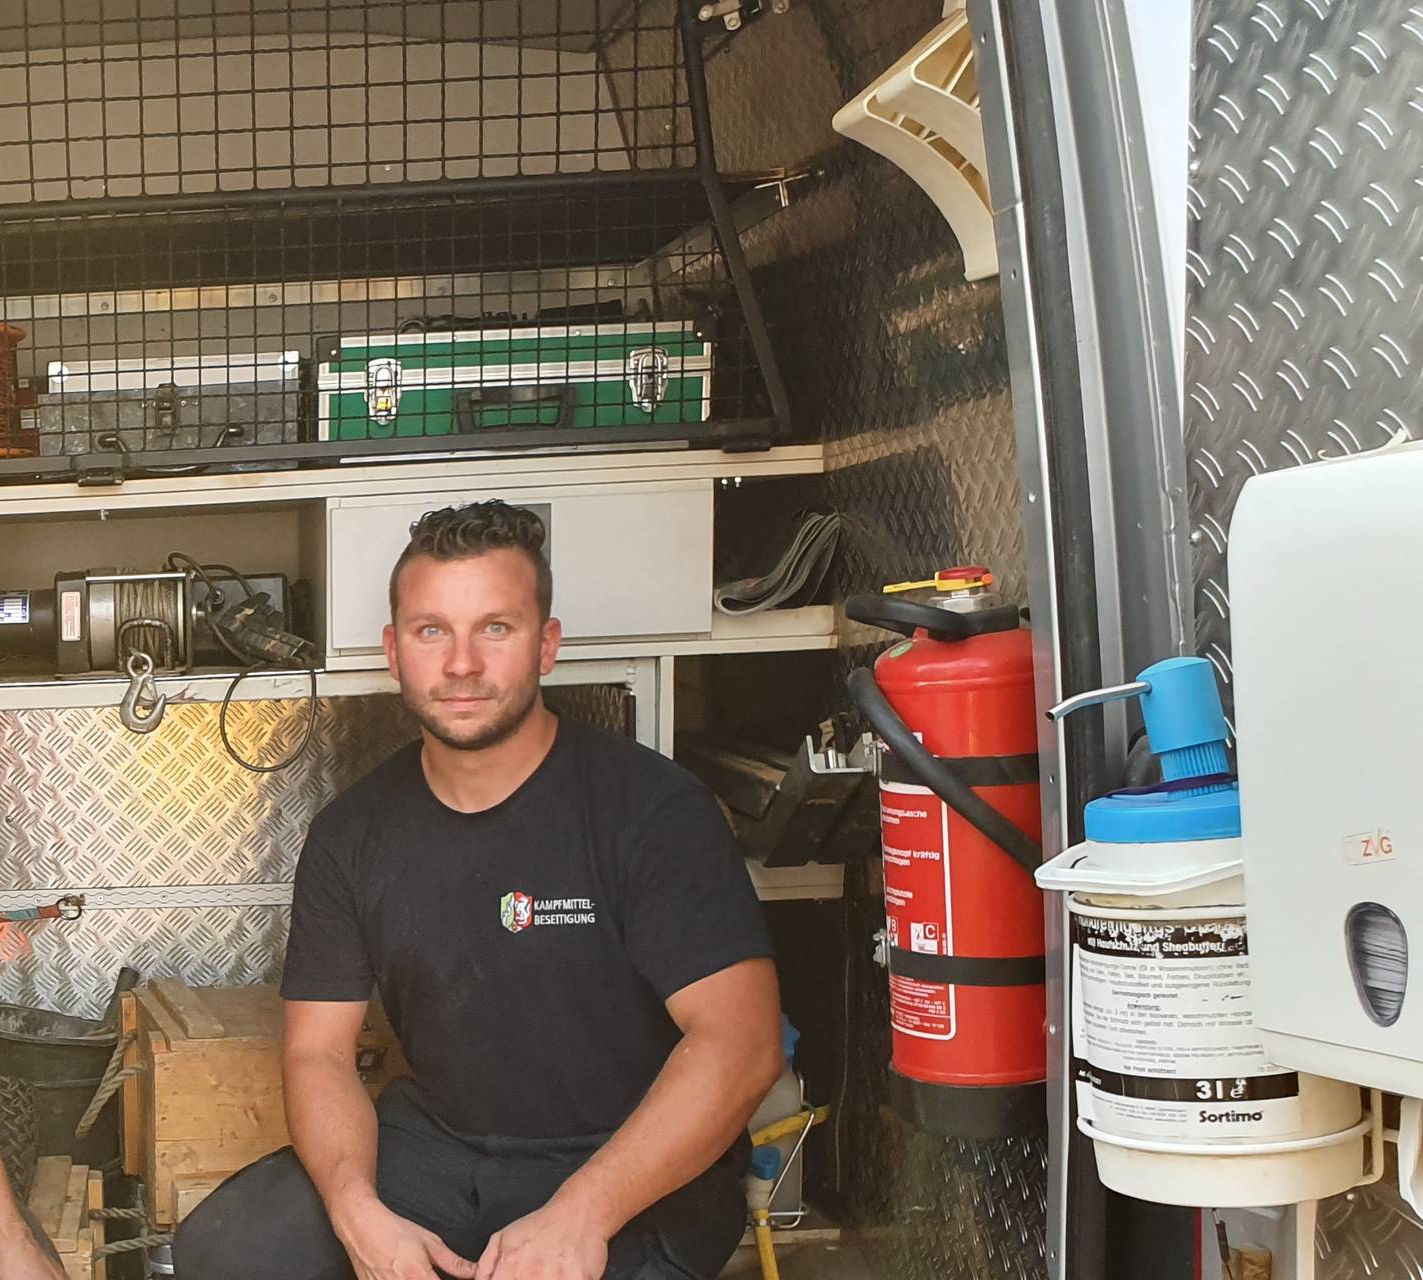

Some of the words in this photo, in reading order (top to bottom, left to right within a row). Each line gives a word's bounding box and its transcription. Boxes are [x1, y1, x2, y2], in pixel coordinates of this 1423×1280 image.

[534, 898, 596, 911] KAMPFMITTEL-
[534, 913, 596, 926] BESEITIGUNG
[1199, 1109, 1263, 1122] Sortimo
